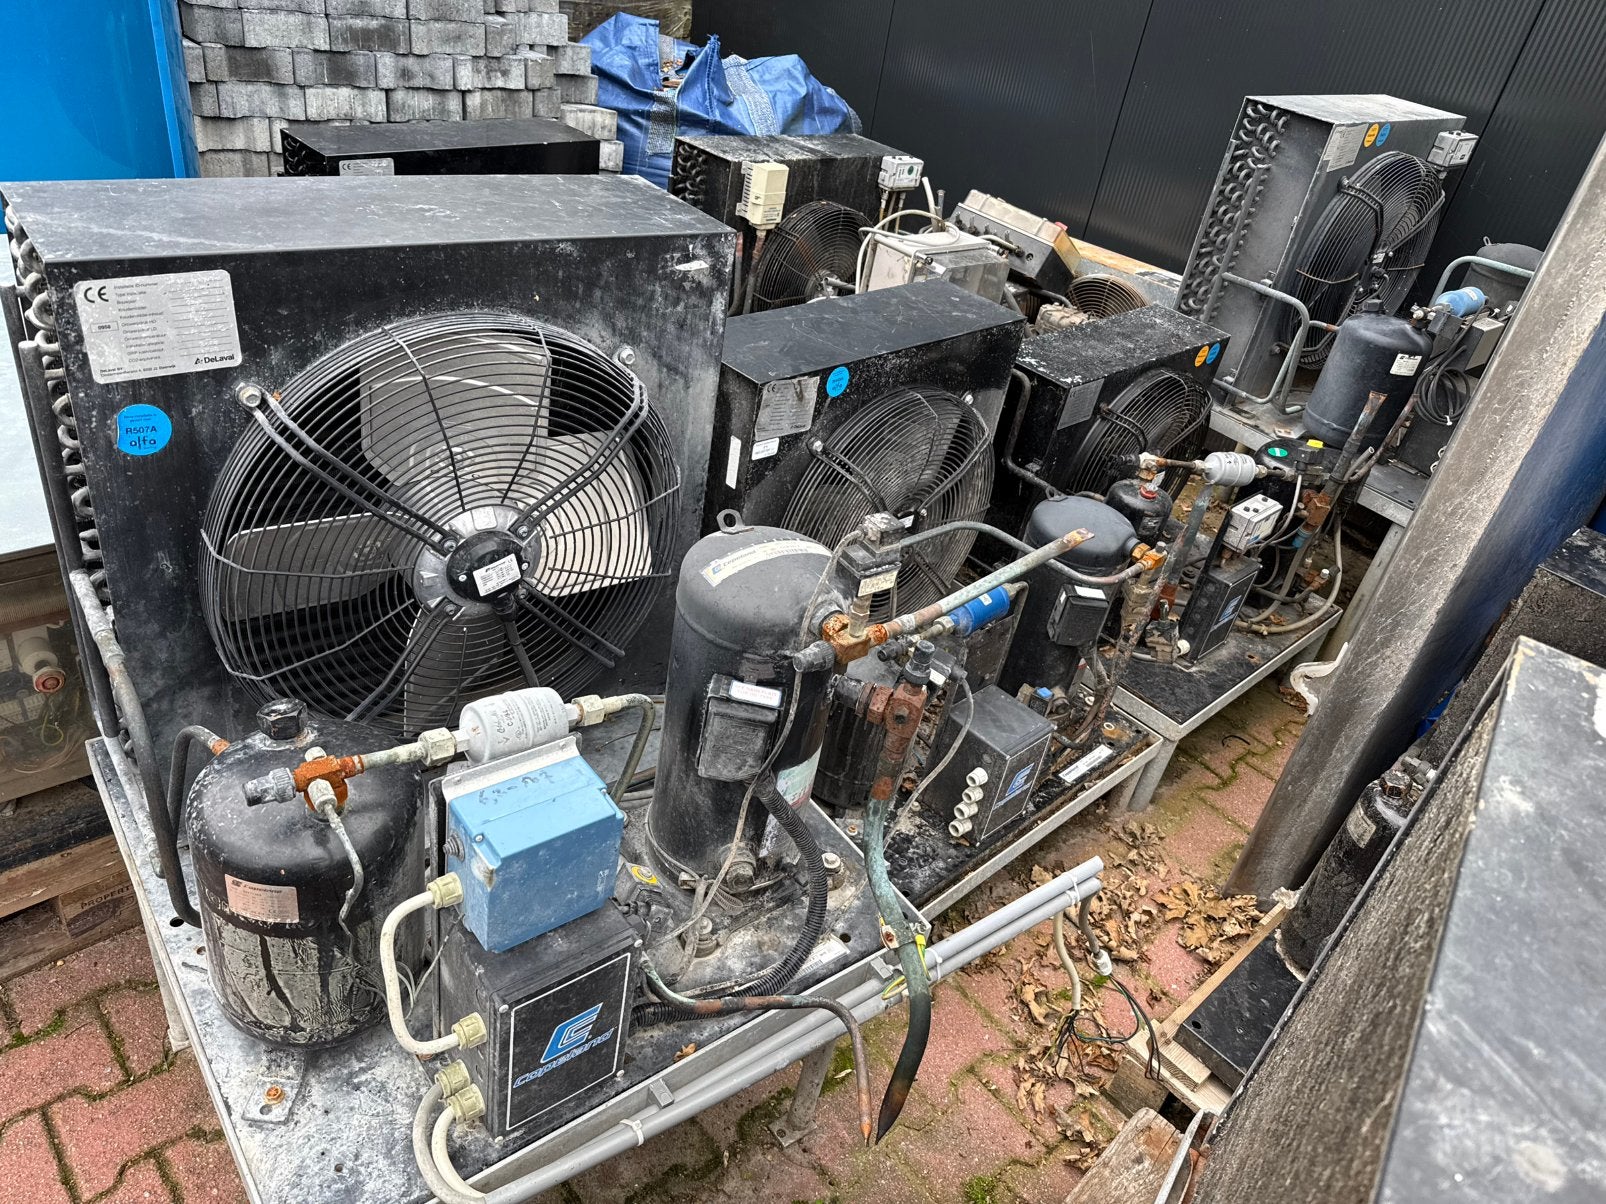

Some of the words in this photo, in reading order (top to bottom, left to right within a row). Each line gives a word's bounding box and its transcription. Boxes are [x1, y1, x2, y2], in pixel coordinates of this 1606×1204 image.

[83, 285, 110, 304] CE
[203, 353, 235, 365] DeLaval
[125, 425, 158, 435] R507A
[129, 435, 158, 450] alfa
[80, 884, 132, 910] PROPERT
